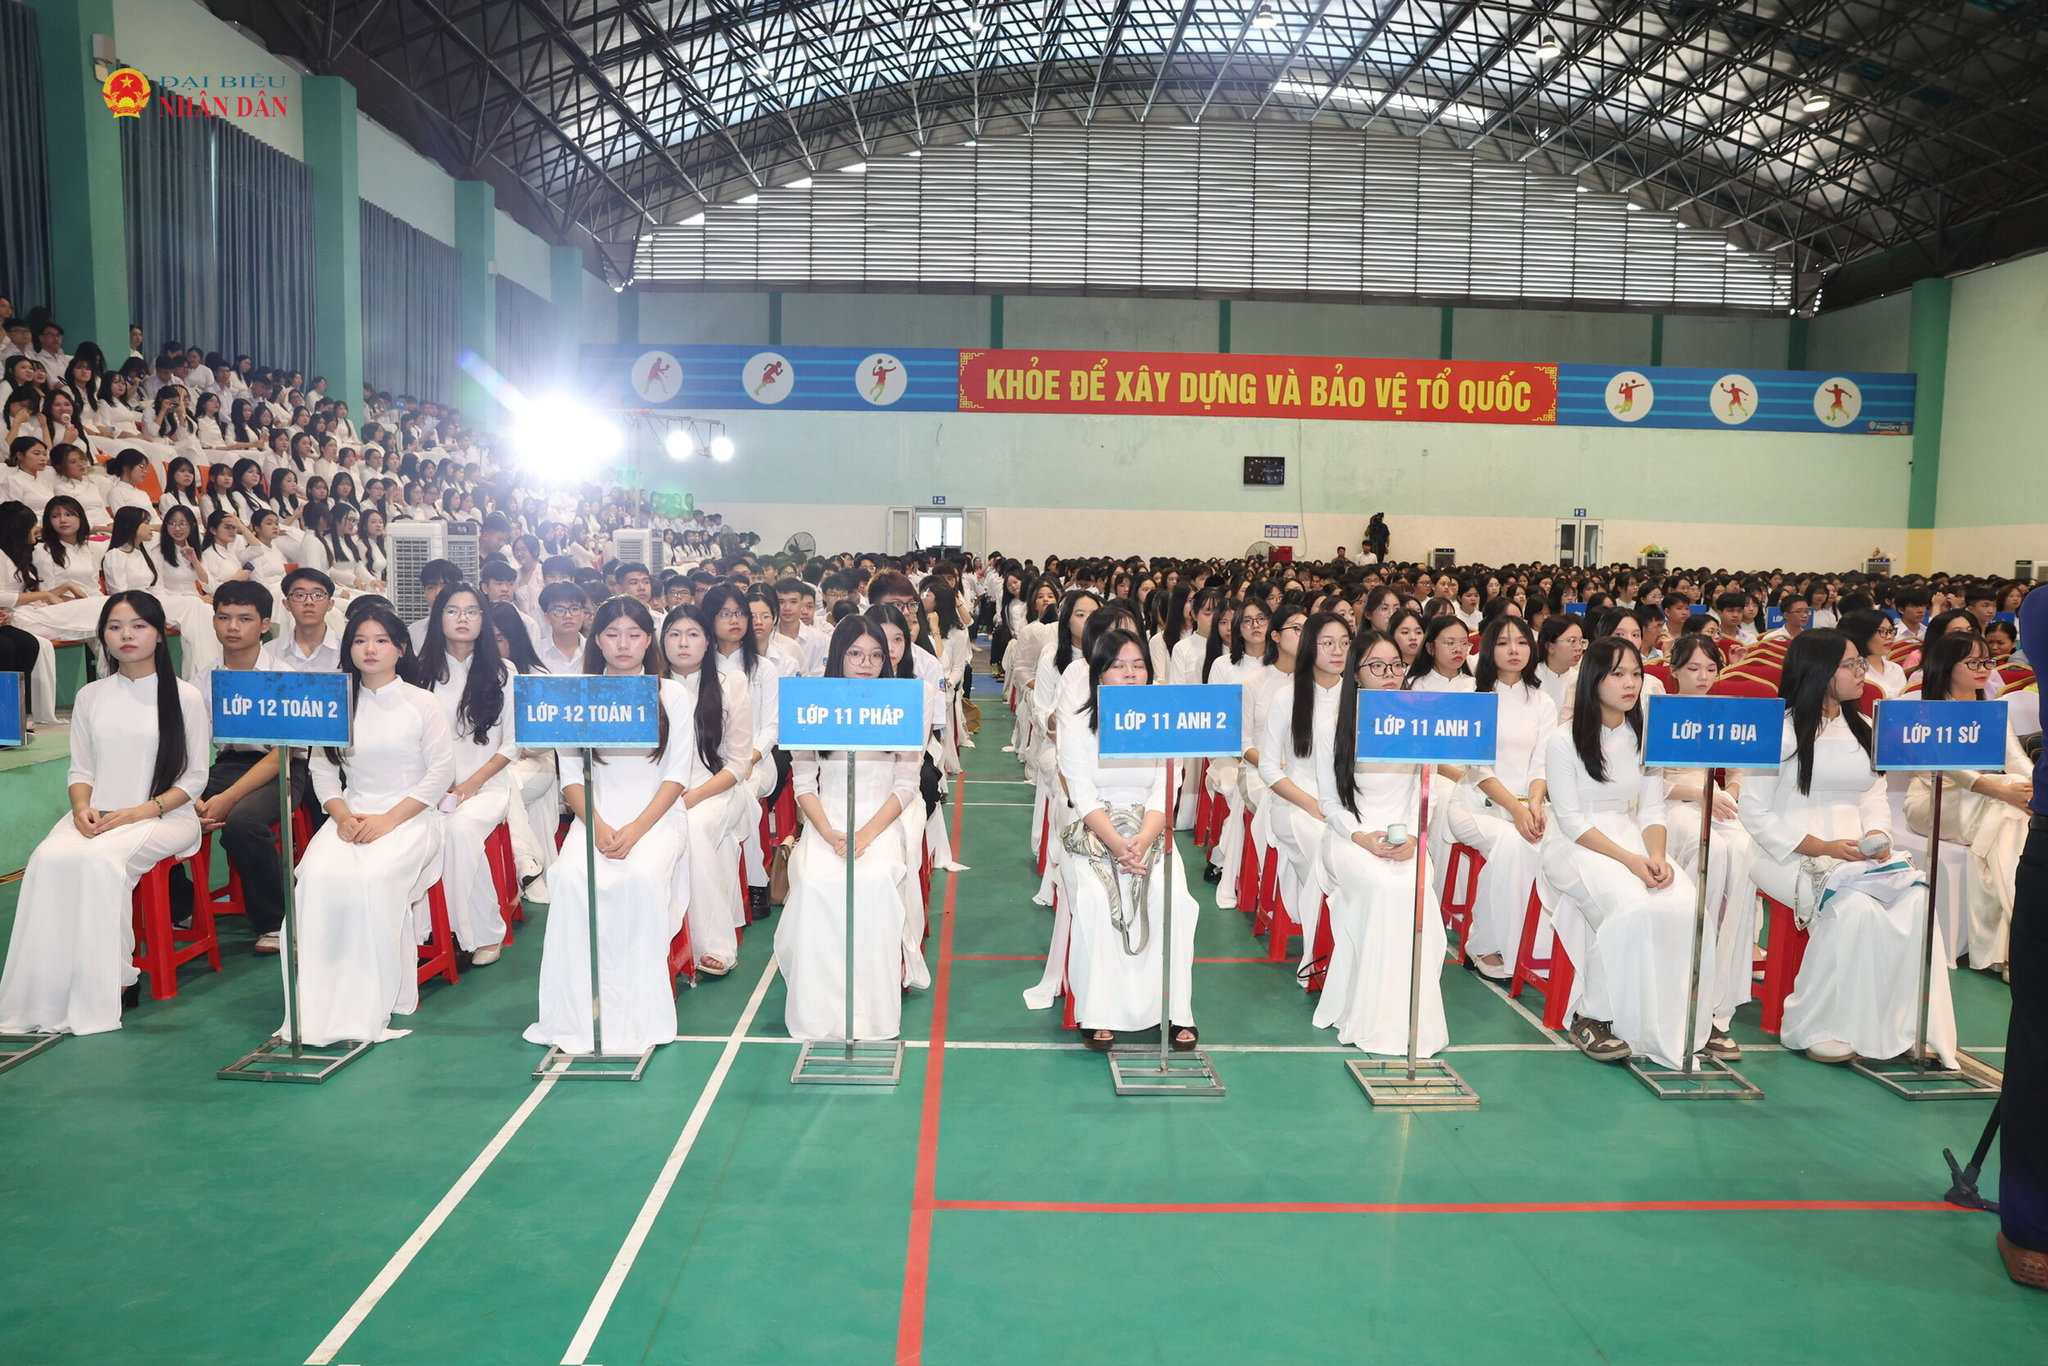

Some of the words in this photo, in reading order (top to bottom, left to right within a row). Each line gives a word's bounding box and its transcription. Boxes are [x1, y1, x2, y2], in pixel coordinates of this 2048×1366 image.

[986, 356, 1060, 401] KHỎE
[1069, 358, 1109, 401] ĐỂ
[1115, 364, 1171, 403] XÂY
[1179, 369, 1257, 410] DỰNG
[1266, 368, 1301, 406] VÀ
[1310, 363, 1366, 408] BẢO
[1375, 371, 1407, 415] VỆ
[1417, 367, 1451, 410] TỔ
[1458, 370, 1531, 414] QUỐC
[222, 693, 253, 716] LỚP
[258, 699, 277, 716] 12
[281, 695, 323, 718] TOÁN
[328, 701, 338, 718] 2
[527, 701, 559, 722] LỚP
[563, 705, 584, 722] 12
[588, 701, 632, 722] TOÁN
[637, 705, 645, 722] 1
[797, 704, 829, 725] LỚP
[834, 707, 852, 725] 11
[859, 704, 904, 725] PHÁP
[1115, 709, 1146, 730] LỚP
[1152, 712, 1170, 730] 11
[1176, 712, 1211, 729] ANH
[1216, 712, 1226, 729] 2
[1374, 714, 1406, 735] LỚP
[1410, 719, 1428, 736] 11
[1434, 719, 1469, 737] ANH
[1473, 720, 1481, 737] 1
[1672, 719, 1702, 740] LỚP
[1707, 723, 1724, 740] 11
[1730, 724, 1757, 745] ĐỊA
[1902, 722, 1931, 744] LỚP
[1936, 726, 1952, 744] 11
[1958, 720, 1981, 744] SỬ
